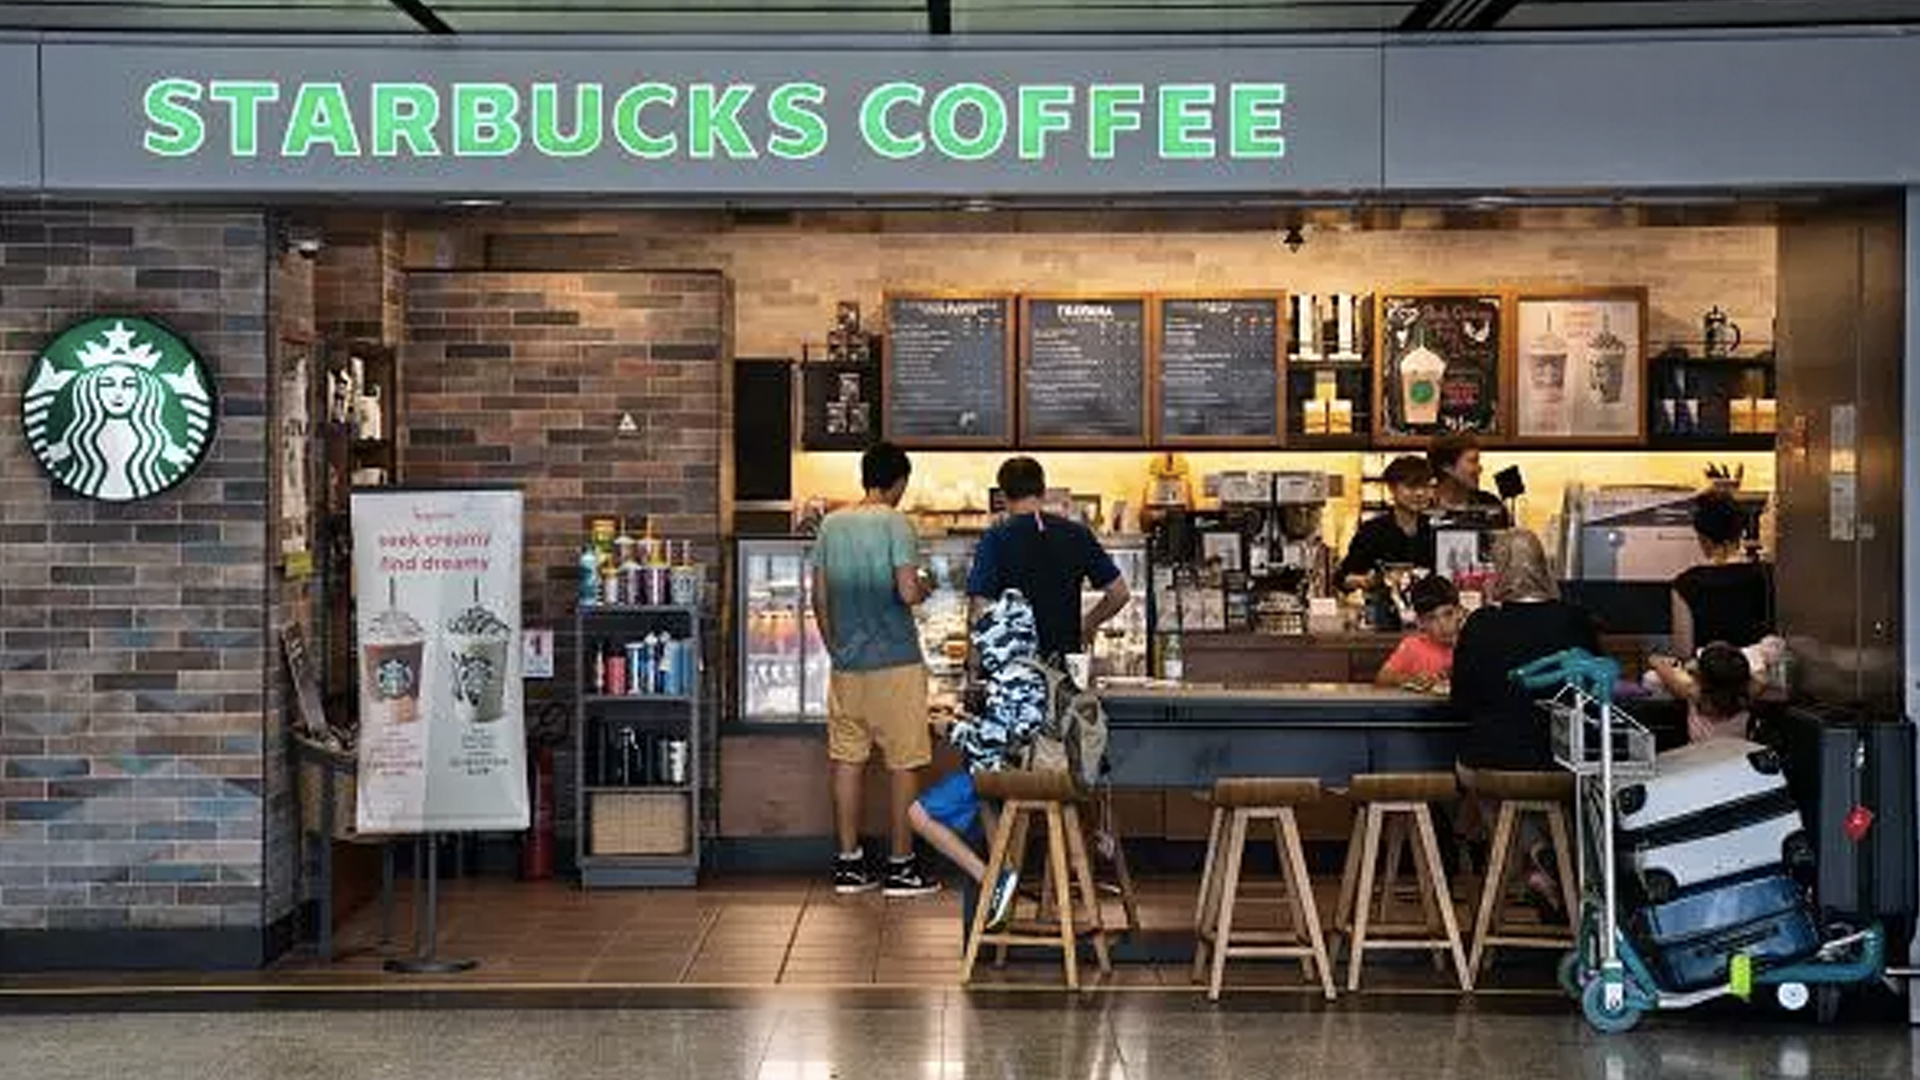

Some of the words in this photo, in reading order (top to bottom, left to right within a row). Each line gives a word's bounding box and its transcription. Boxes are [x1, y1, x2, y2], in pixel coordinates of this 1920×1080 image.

[143, 79, 828, 159] STARBUCKS
[859, 81, 1286, 160] COFFEE
[424, 533, 491, 549] creamy
